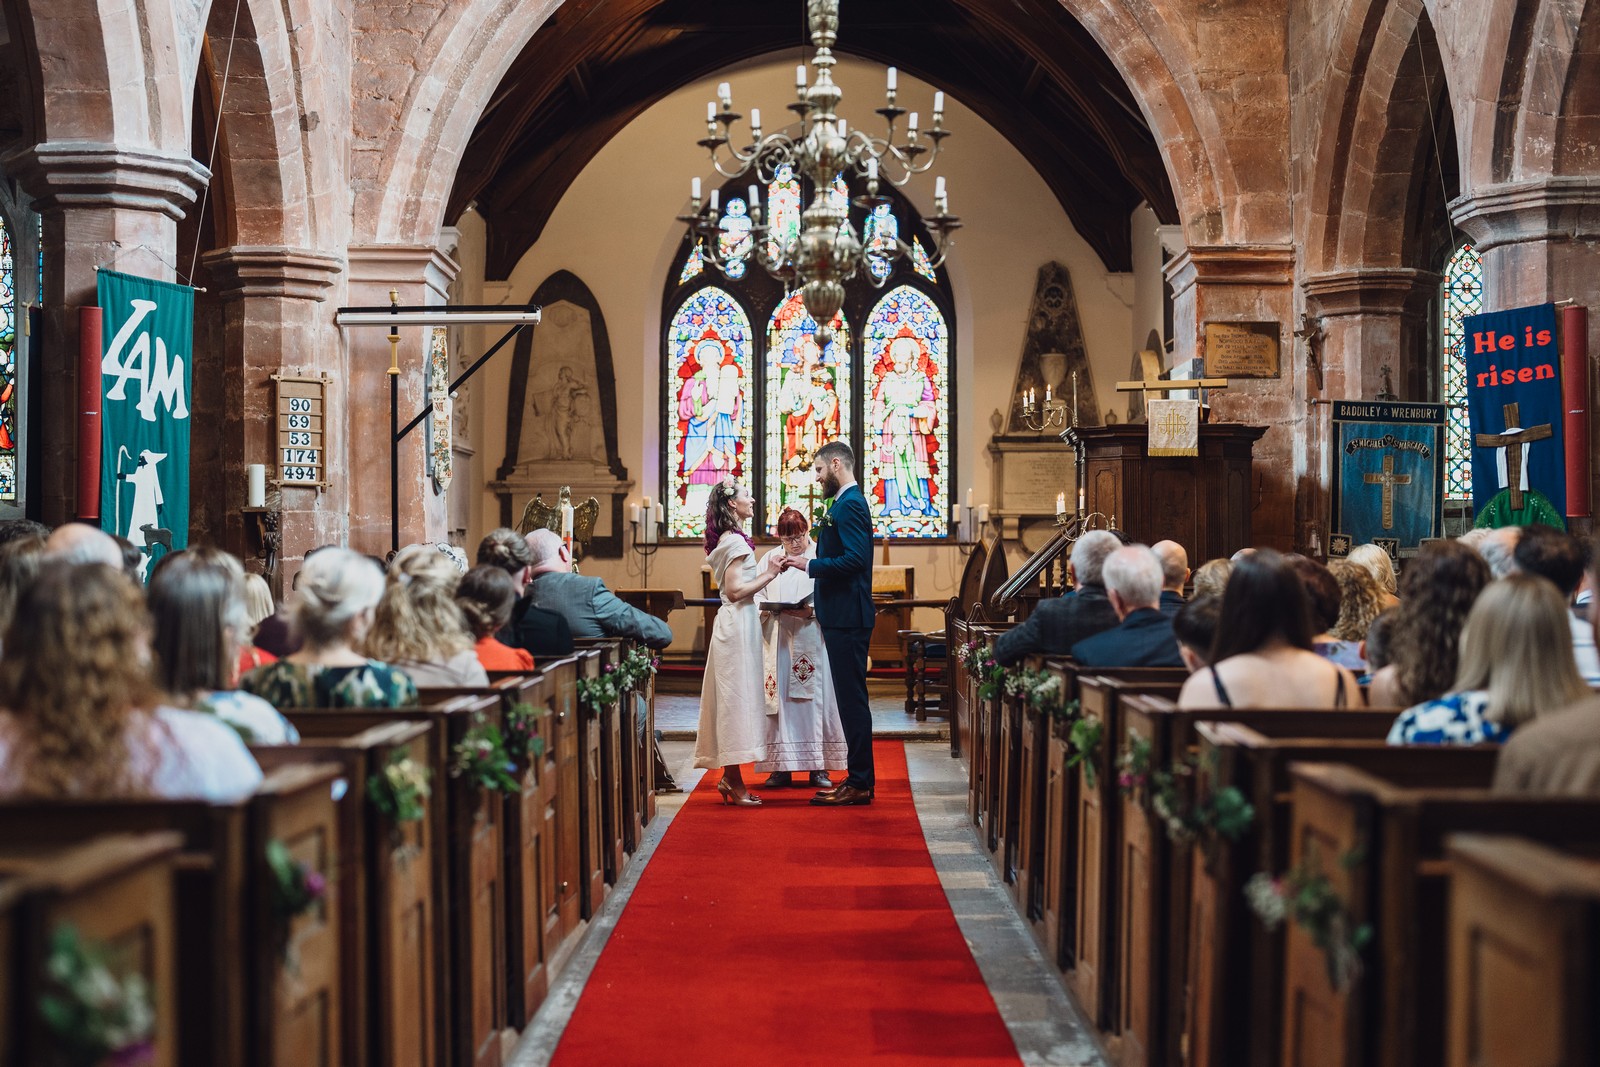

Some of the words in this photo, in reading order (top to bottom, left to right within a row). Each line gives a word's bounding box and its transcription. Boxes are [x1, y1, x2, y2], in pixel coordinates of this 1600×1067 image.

[1473, 331, 1515, 354] He
[1525, 325, 1551, 347] is
[1476, 364, 1555, 387] risen
[290, 399, 310, 411] 90
[1340, 405, 1380, 417] BADDILEY
[1391, 407, 1437, 419] WRENBURY
[289, 415, 309, 428] 69
[290, 433, 310, 445] 53
[286, 450, 316, 462] 174
[285, 467, 315, 480] 494
